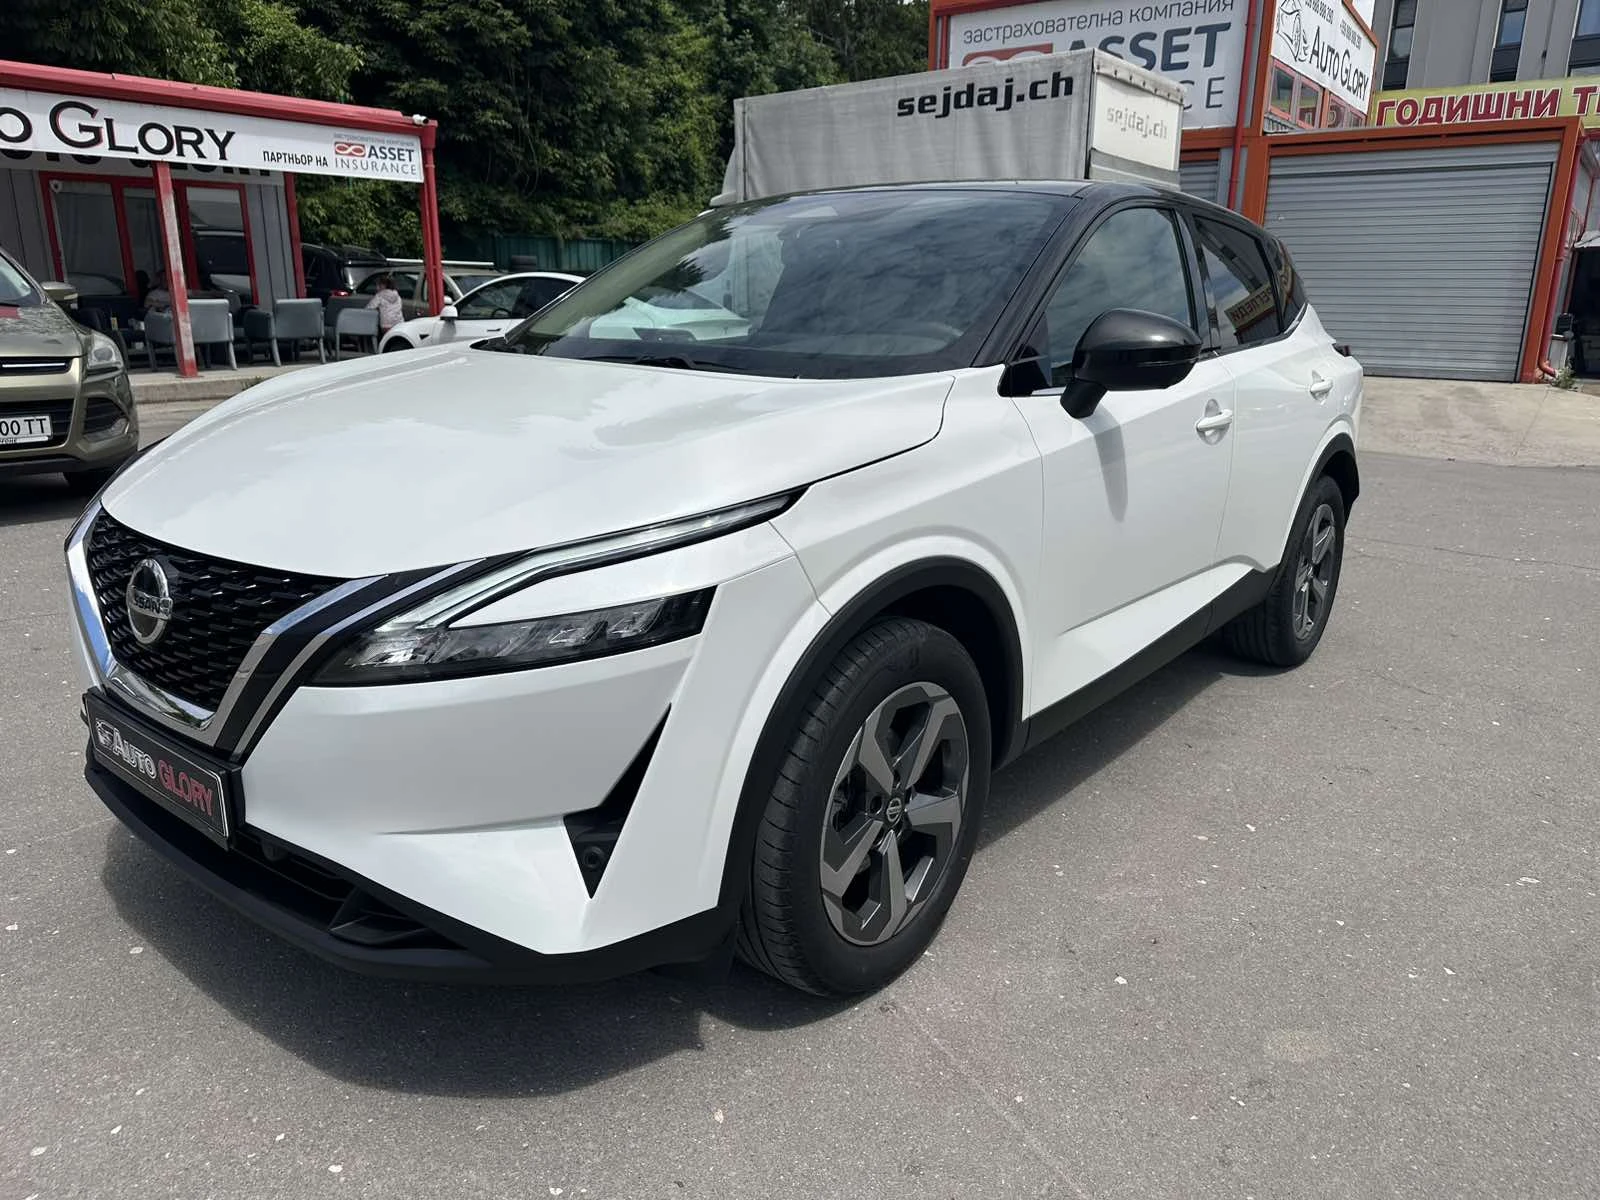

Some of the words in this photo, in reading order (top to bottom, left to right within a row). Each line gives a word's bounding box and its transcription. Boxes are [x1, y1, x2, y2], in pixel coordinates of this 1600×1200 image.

[963, 8, 1123, 45] застрахователна
[1129, 0, 1234, 24] компания
[1340, 49, 1369, 101] GLORY
[897, 72, 1074, 119] sejdaj.ch
[1376, 88, 1563, 127] ГОДИШНИ
[48, 100, 236, 161] GLORY
[1106, 107, 1168, 139] sejdaj.ch
[262, 150, 313, 166] ПАРТНЬОР
[316, 155, 329, 168] НА
[334, 157, 417, 176] INSURANCE
[367, 144, 415, 163] ASSET
[24, 418, 46, 434] TT
[112, 727, 157, 779] AUTO
[157, 760, 214, 817] GLORY
